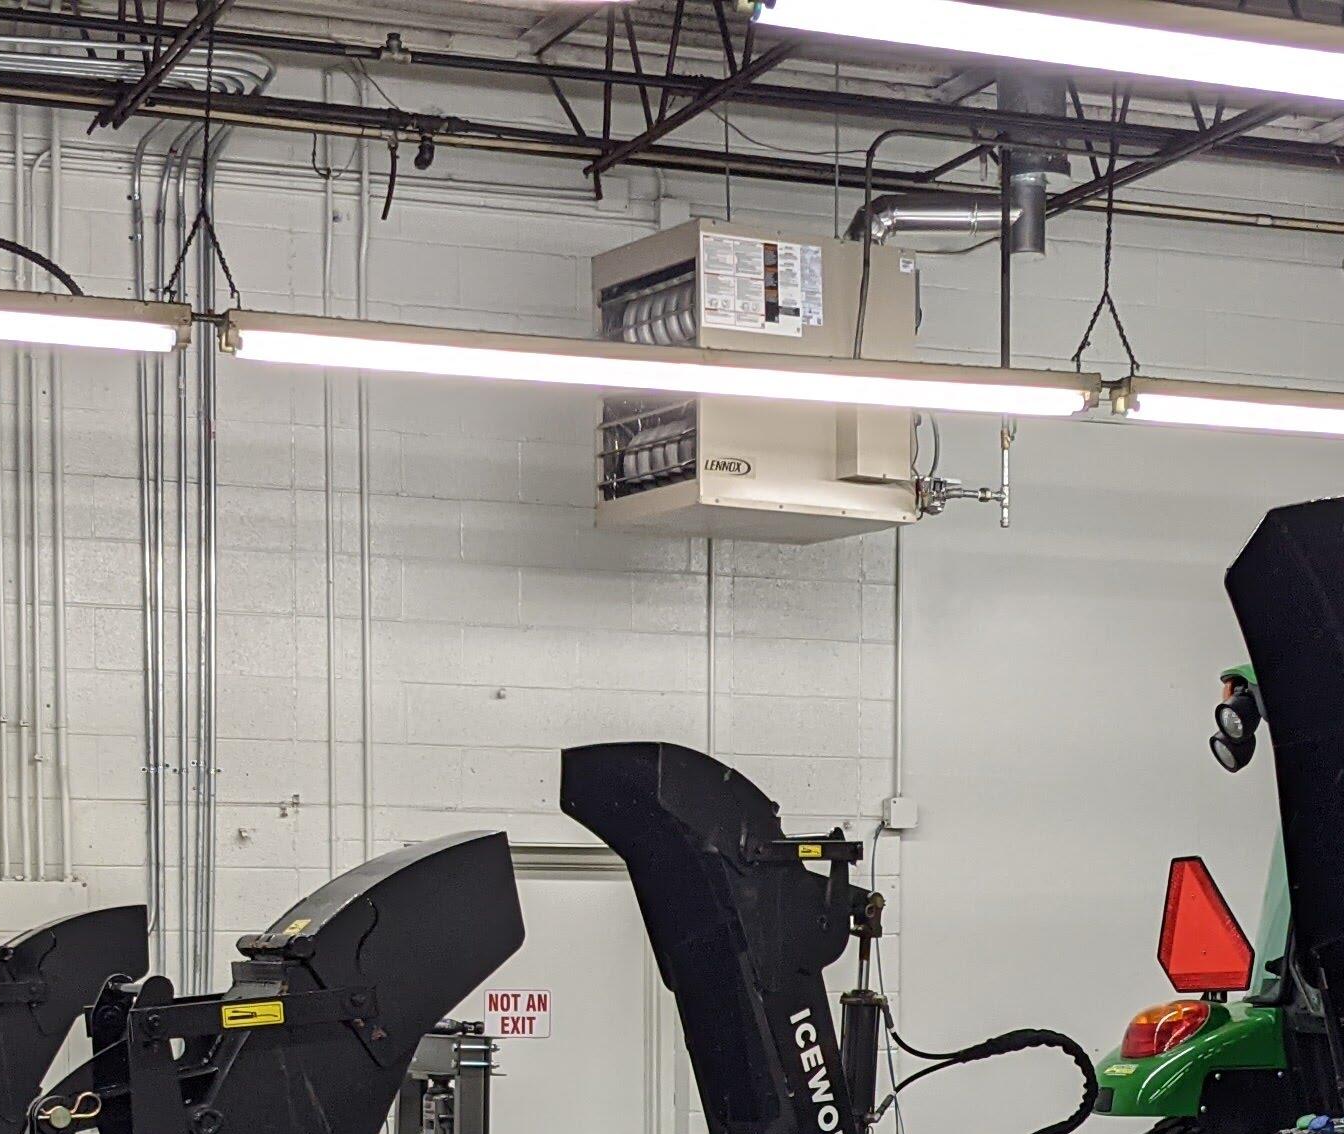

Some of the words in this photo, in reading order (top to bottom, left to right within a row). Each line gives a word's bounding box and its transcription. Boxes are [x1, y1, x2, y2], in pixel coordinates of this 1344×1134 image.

[704, 459, 742, 473] LENNOX
[488, 993, 521, 1012] NOT
[526, 993, 548, 1012] AN
[501, 1016, 536, 1035] EXIT
